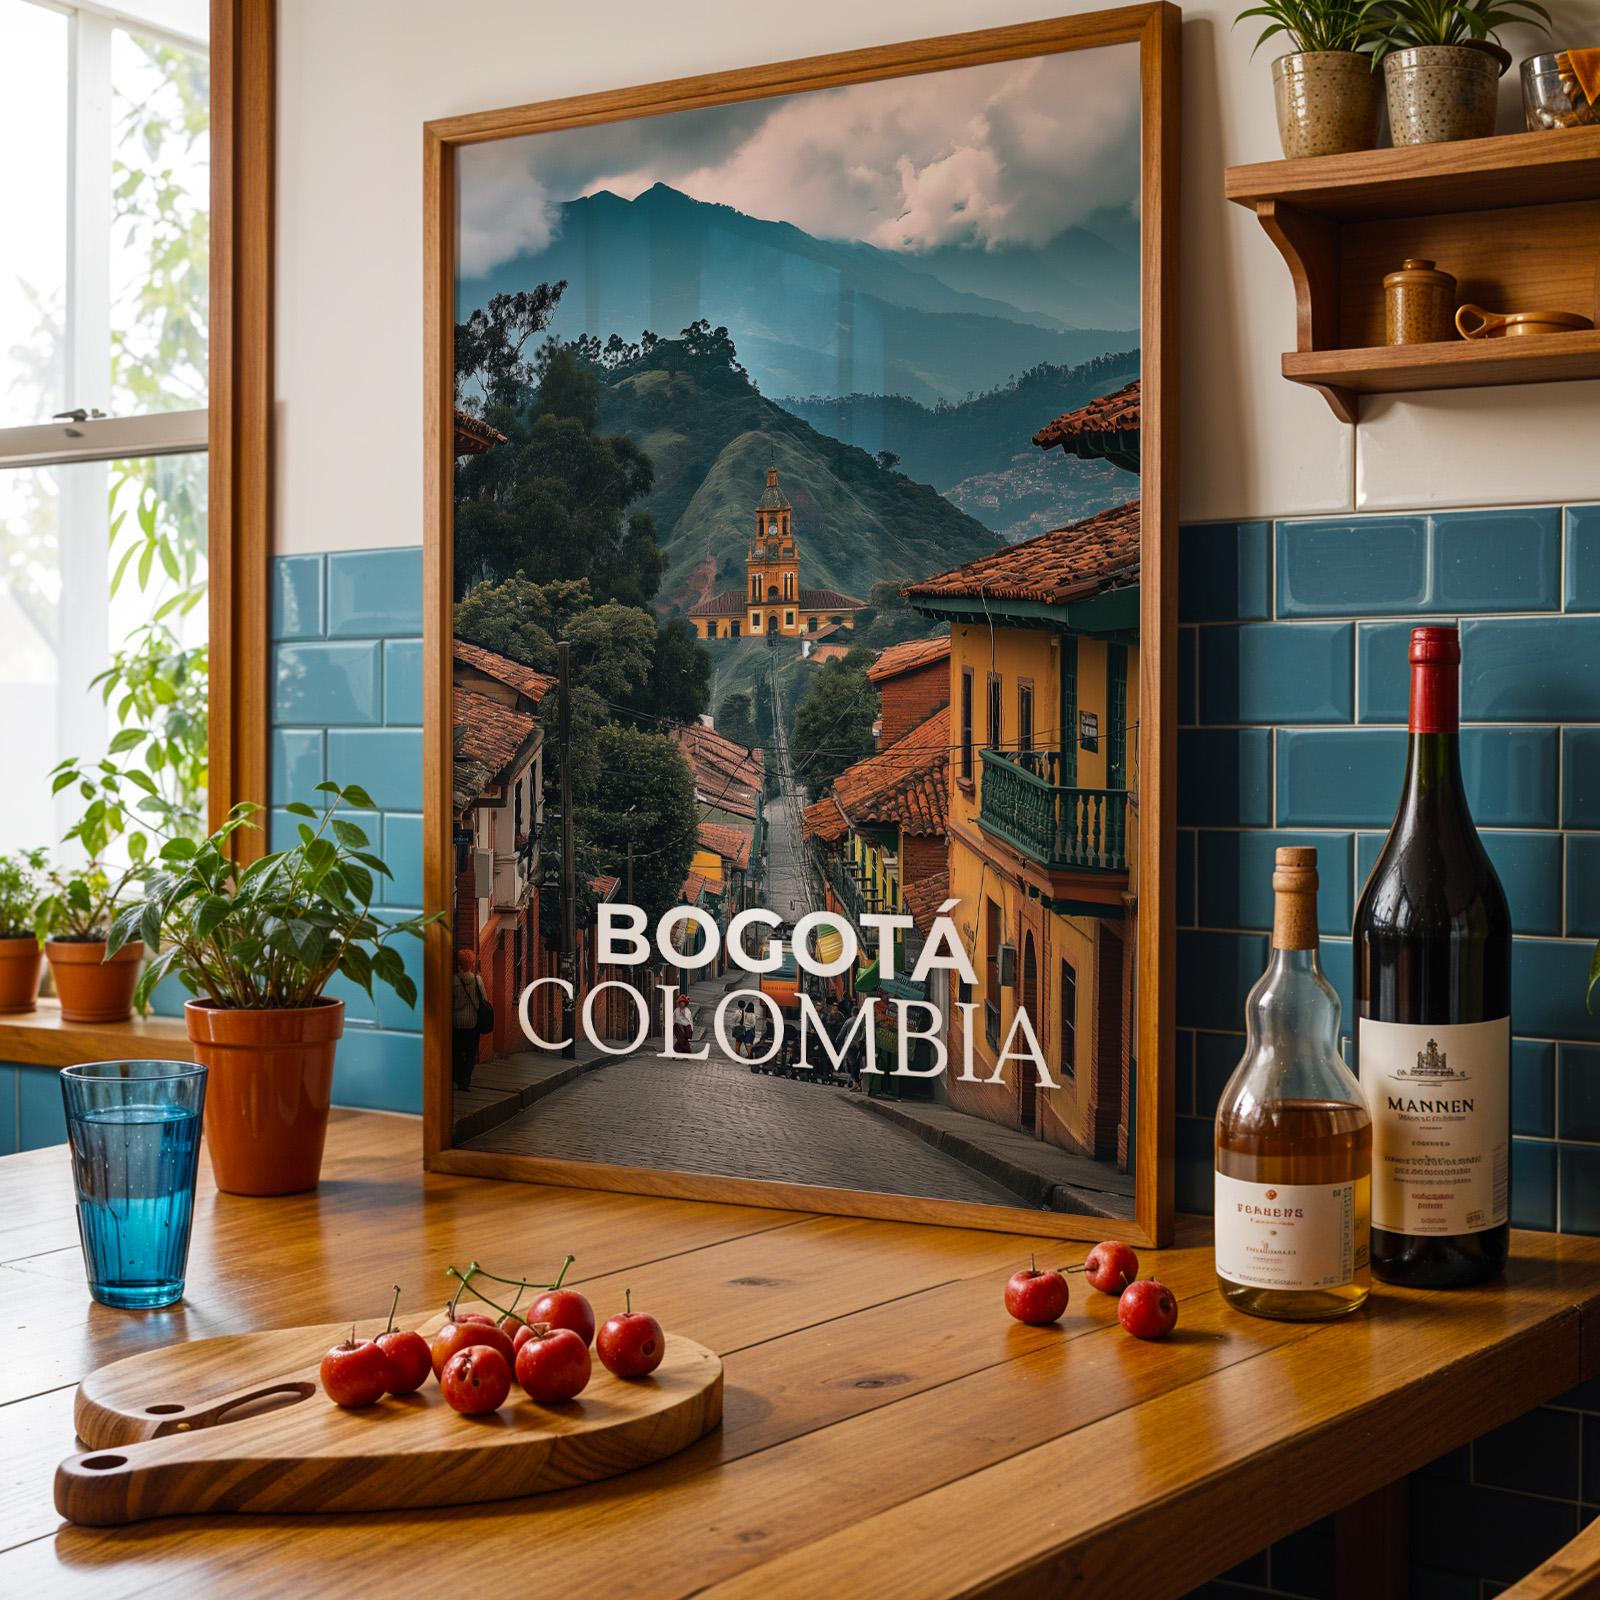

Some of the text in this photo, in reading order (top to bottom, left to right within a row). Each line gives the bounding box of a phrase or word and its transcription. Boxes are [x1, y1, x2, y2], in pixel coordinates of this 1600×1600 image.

[597, 898, 979, 985] BOGOTÁ
[518, 977, 1062, 1089] COLOMBIA
[1387, 1096, 1475, 1113] MANNEN
